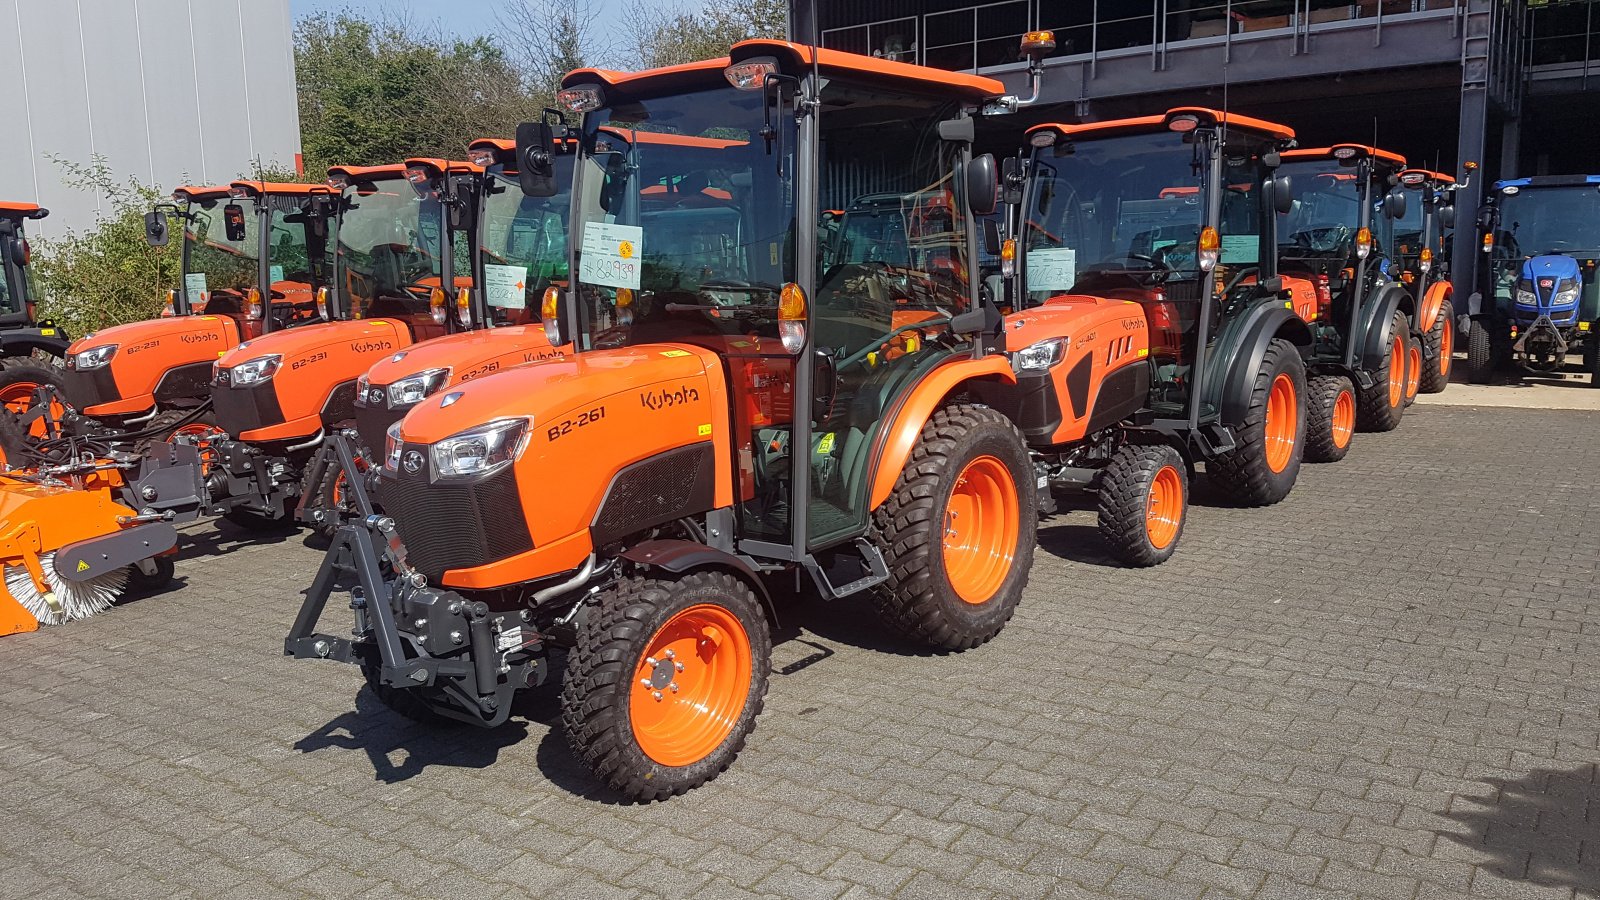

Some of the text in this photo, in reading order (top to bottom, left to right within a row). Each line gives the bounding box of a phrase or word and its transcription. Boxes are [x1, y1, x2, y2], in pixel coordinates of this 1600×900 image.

[1121, 317, 1145, 331] Kubota
[181, 332, 219, 344] Kubota
[127, 340, 160, 355] B2-231
[350, 340, 392, 355] Kubota
[291, 351, 328, 371] B2-231
[640, 385, 699, 411] Kubota
[547, 406, 606, 442] B2-261
